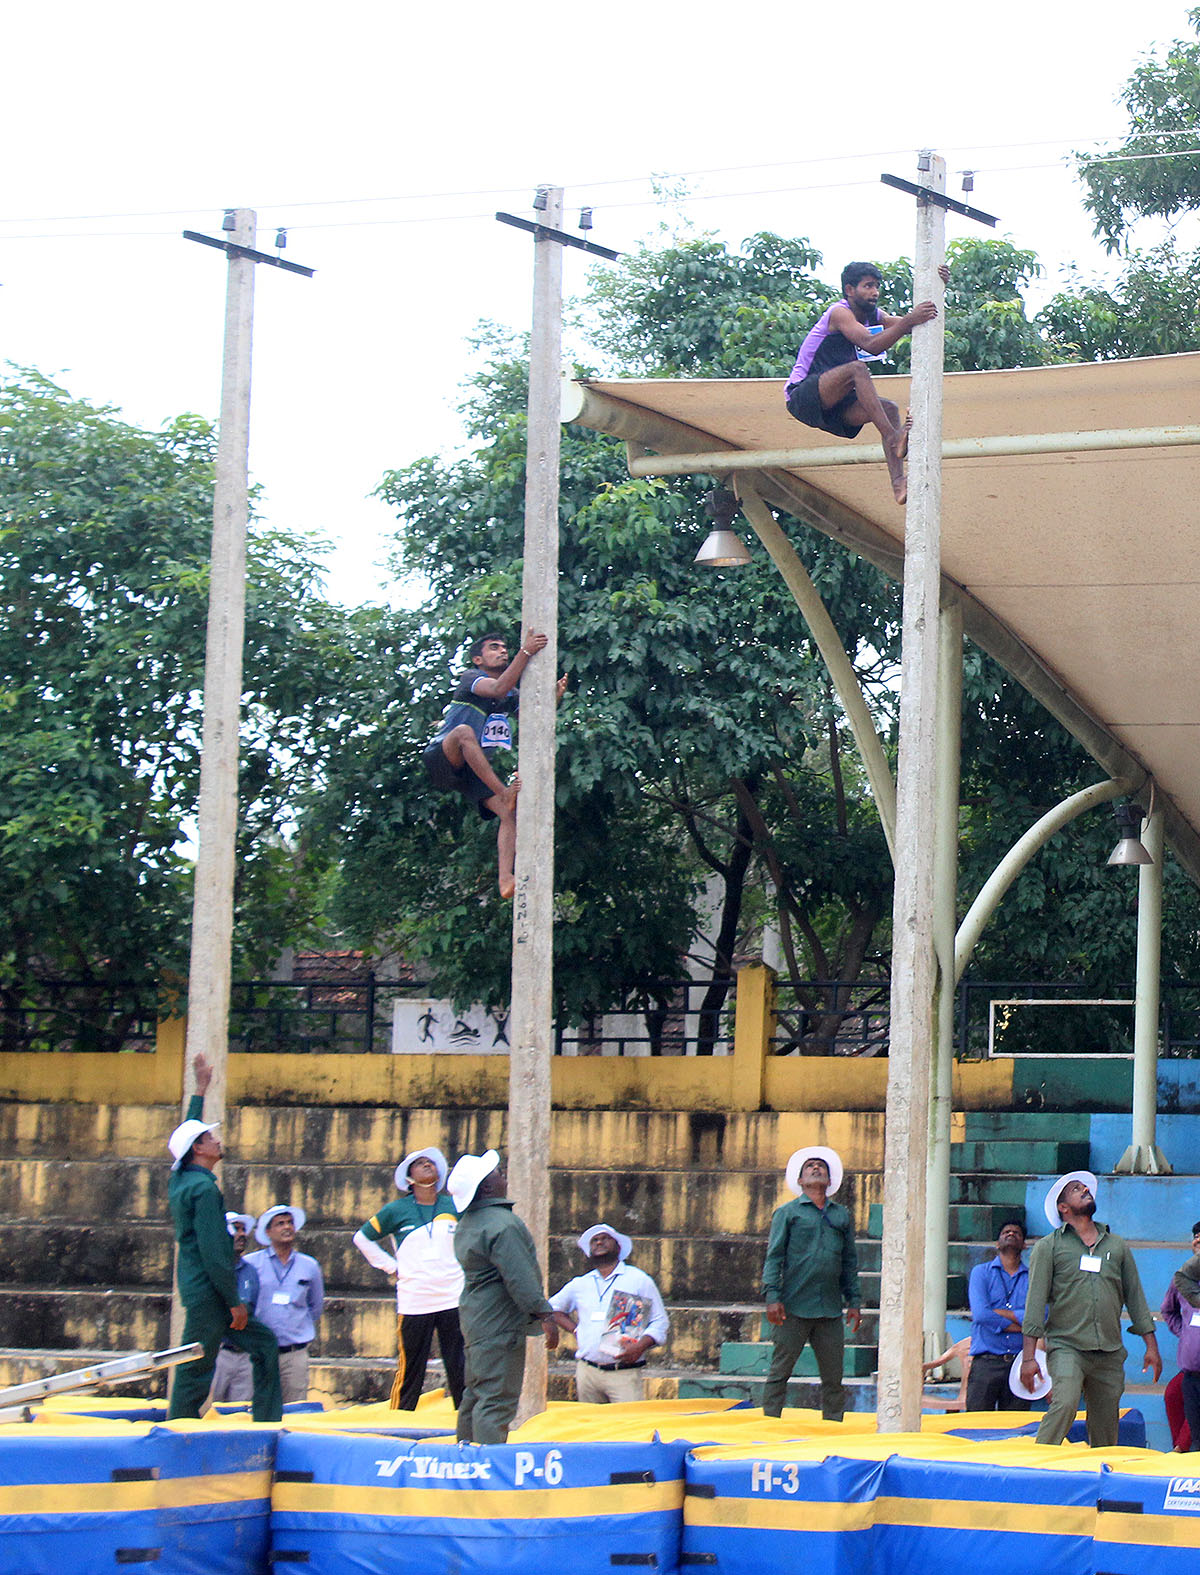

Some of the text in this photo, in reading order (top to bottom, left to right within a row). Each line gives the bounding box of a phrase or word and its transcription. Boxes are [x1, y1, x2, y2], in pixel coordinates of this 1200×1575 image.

[410, 1449, 564, 1486] Vinex P-6
[752, 1462, 800, 1494] H-3
